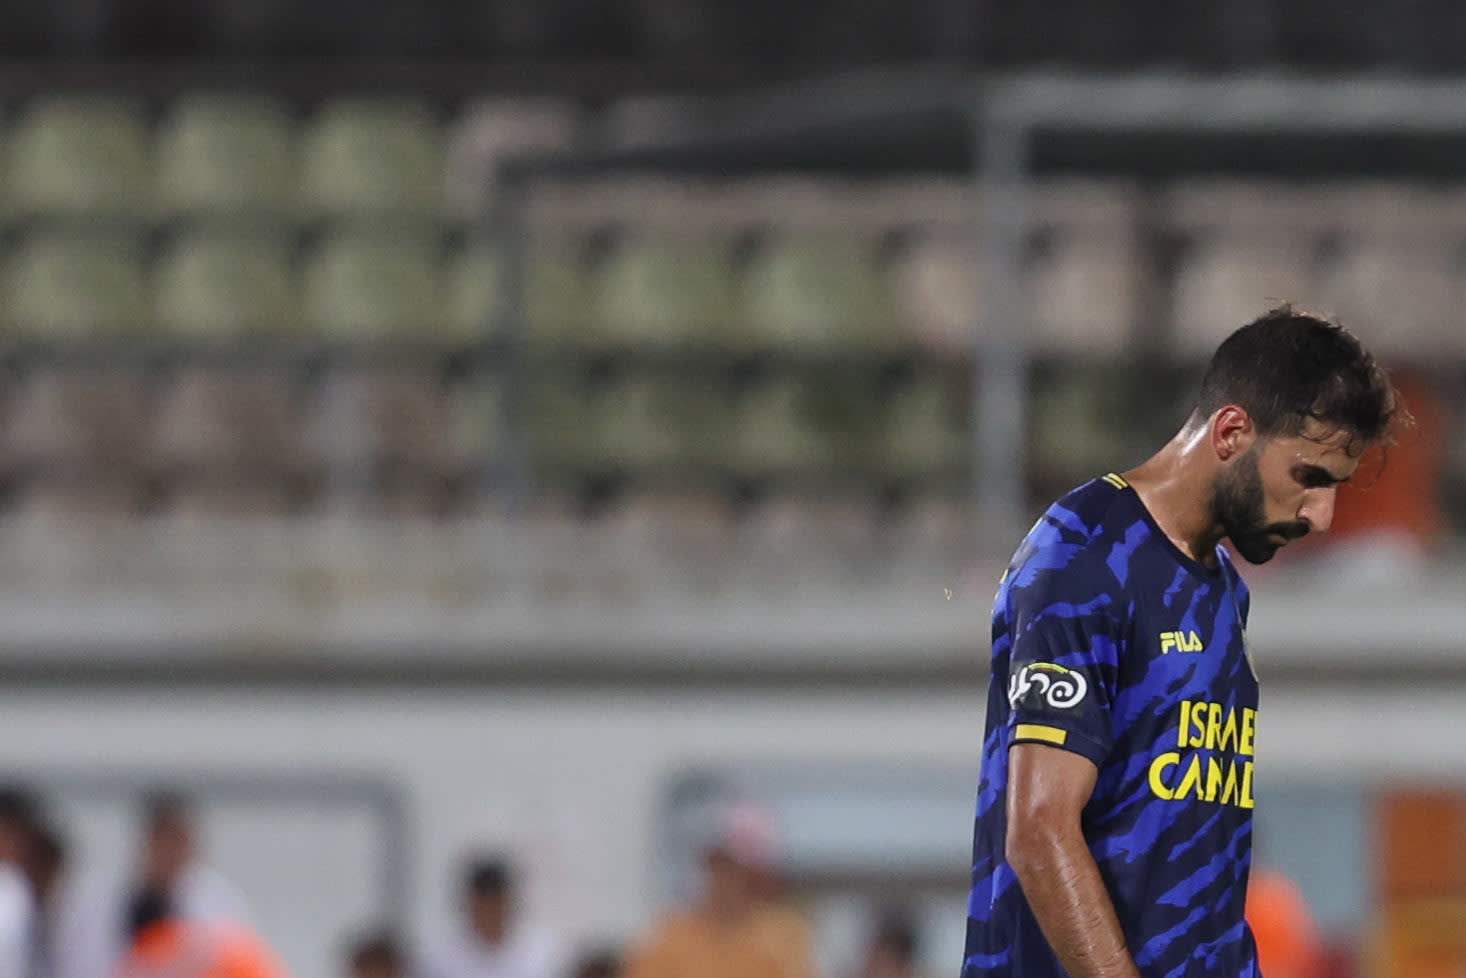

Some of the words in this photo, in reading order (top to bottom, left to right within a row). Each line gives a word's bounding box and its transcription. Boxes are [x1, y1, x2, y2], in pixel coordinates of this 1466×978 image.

[1160, 630, 1203, 654] FILA
[1177, 700, 1257, 755] ISRAE
[1148, 752, 1255, 809] CANA
